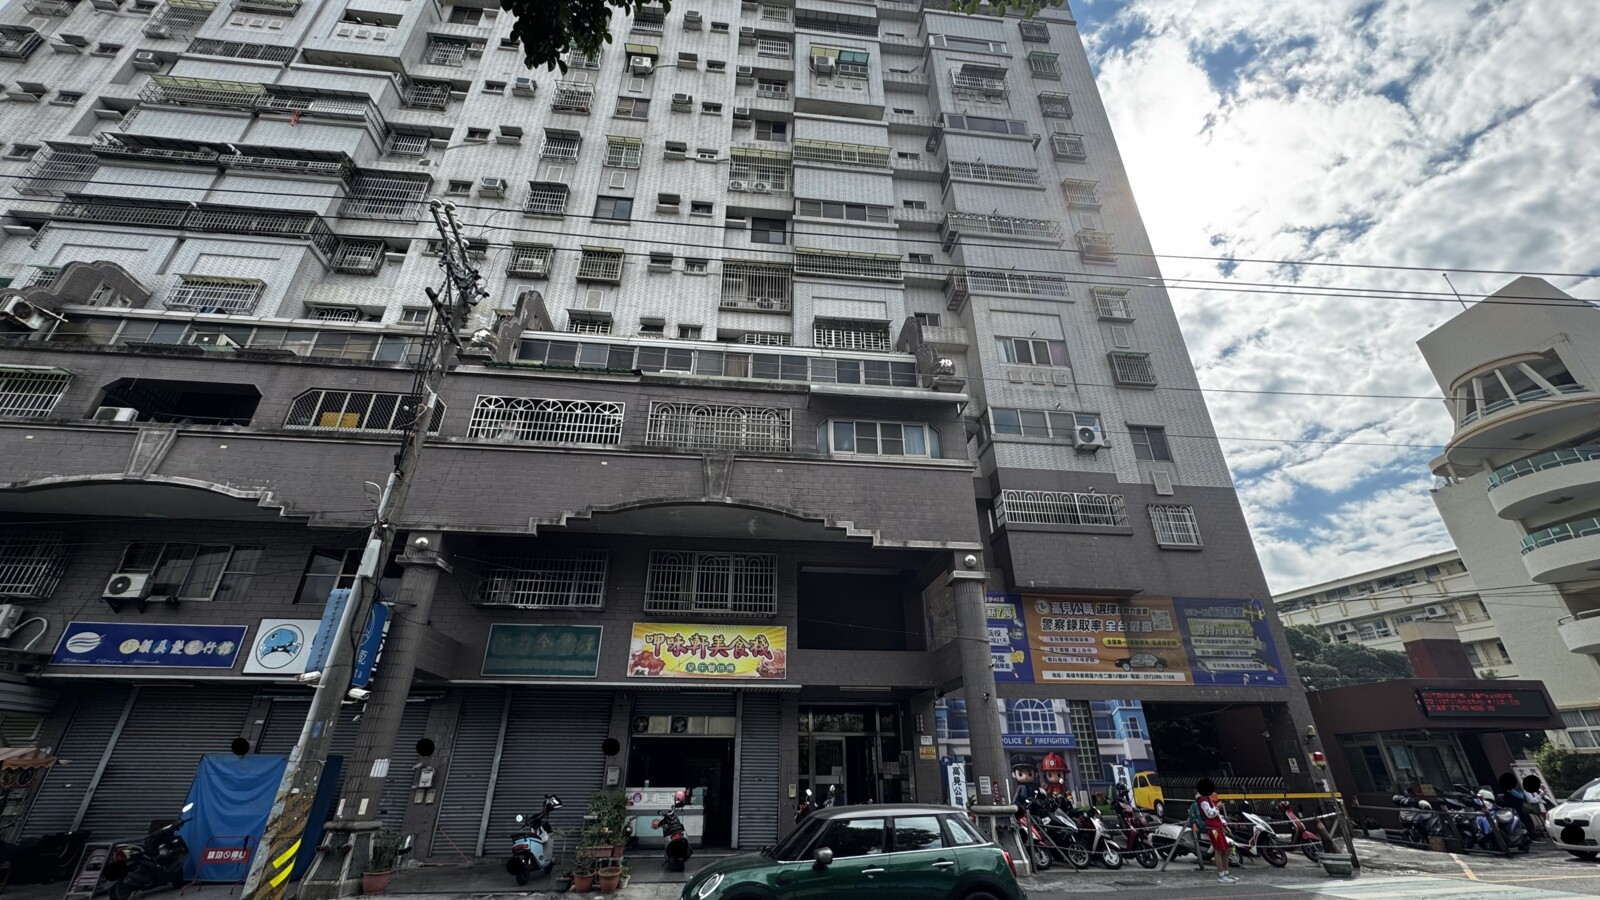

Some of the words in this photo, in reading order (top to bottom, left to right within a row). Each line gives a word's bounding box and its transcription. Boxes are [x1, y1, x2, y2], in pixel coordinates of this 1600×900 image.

[1051, 601, 1094, 616] 高見公職
[1041, 618, 1102, 632] 警察錄取率
[1105, 620, 1153, 633] 全台最高
[645, 633, 773, 660] 呷味軒美食棧
[1035, 737, 1070, 745] FIREFIGHTER
